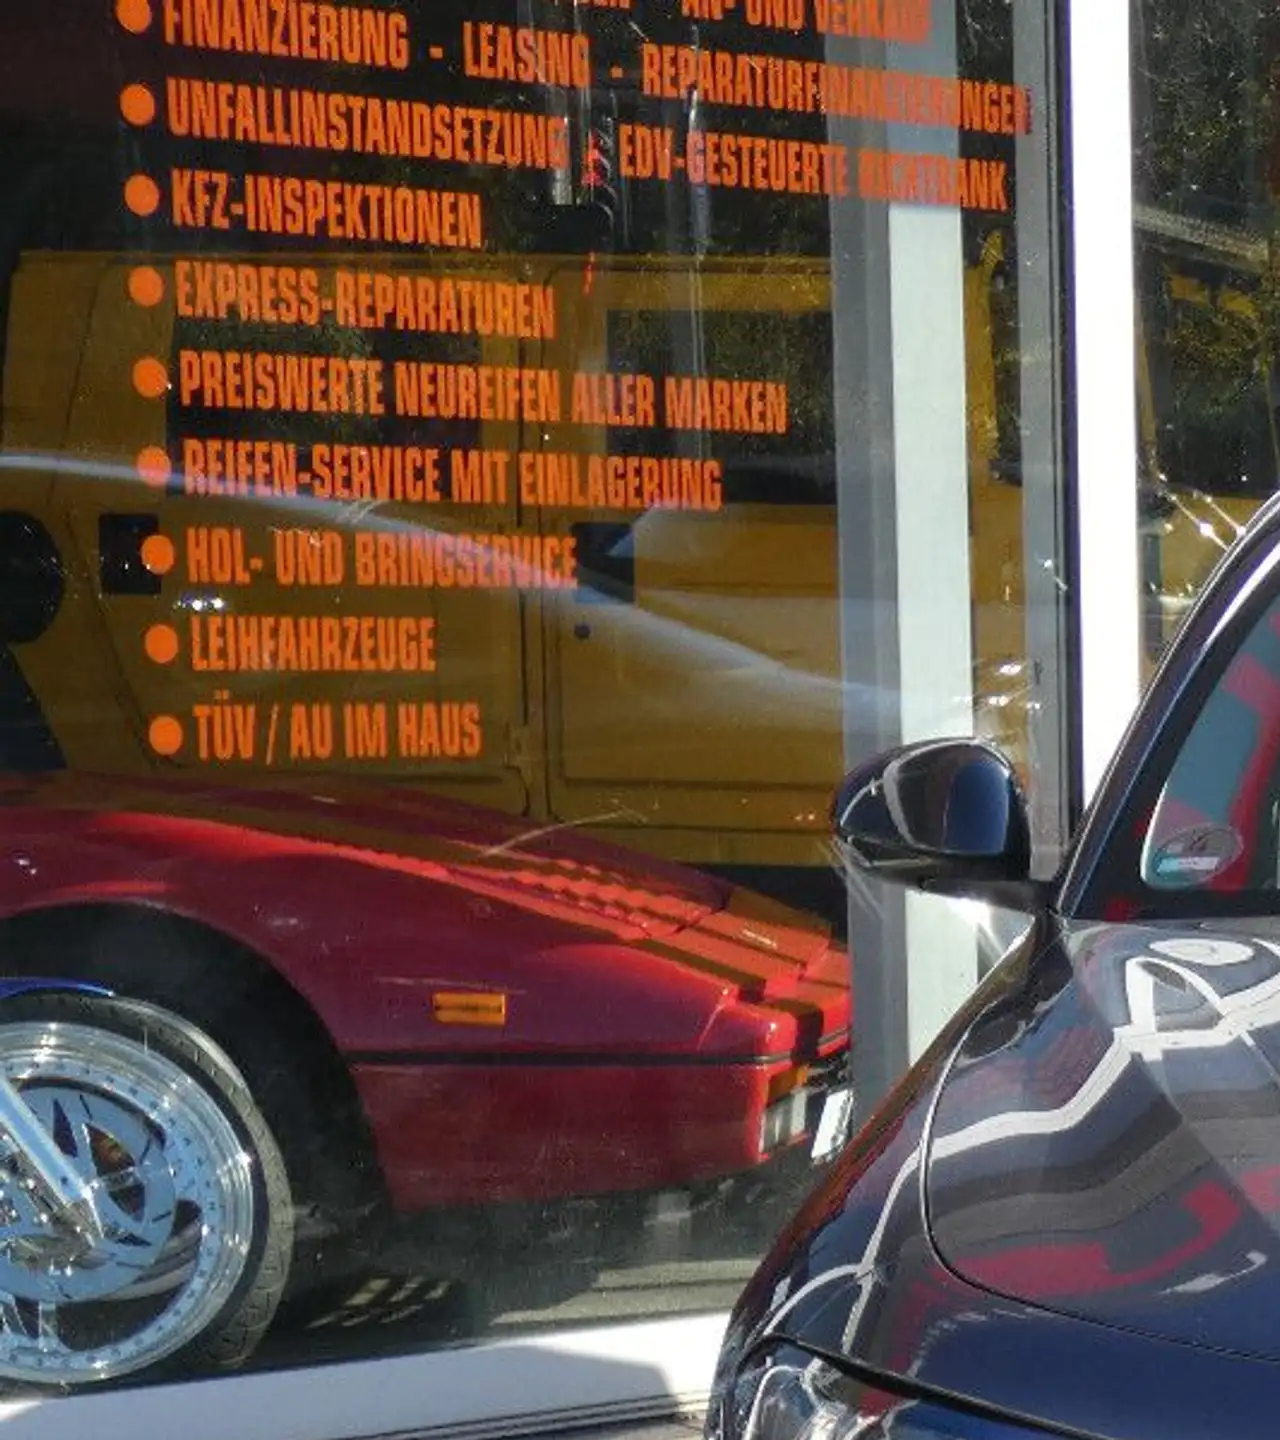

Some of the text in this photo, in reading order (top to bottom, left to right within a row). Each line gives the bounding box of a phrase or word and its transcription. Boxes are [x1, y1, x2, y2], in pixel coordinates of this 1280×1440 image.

[164, 0, 409, 70] FINANZIERUNG
[463, 20, 590, 89] LEASING
[642, 43, 1033, 136] REPARATURFINANZIERUNGEN
[166, 76, 570, 171] UNFALLINSTANDSETZUNG
[619, 124, 849, 197] EDV-GESTEUERTE
[171, 168, 483, 248] KFZ-INSPEKTIONEN
[175, 261, 555, 339] EXPRESS-REPARATUREN
[180, 350, 788, 434] PREISWERTE NEUREIFEN ALLER MARKEN
[183, 438, 723, 512] REIFEN-SERVICE MIT EINLAGERUNG
[187, 527, 578, 590] HOL- UND BRINGSERVICE
[191, 617, 437, 672] LEIHFAHRZEUGE
[192, 690, 255, 760] TÜV
[289, 704, 333, 758] AU
[345, 704, 388, 758] IM
[399, 703, 482, 758] HAUS
